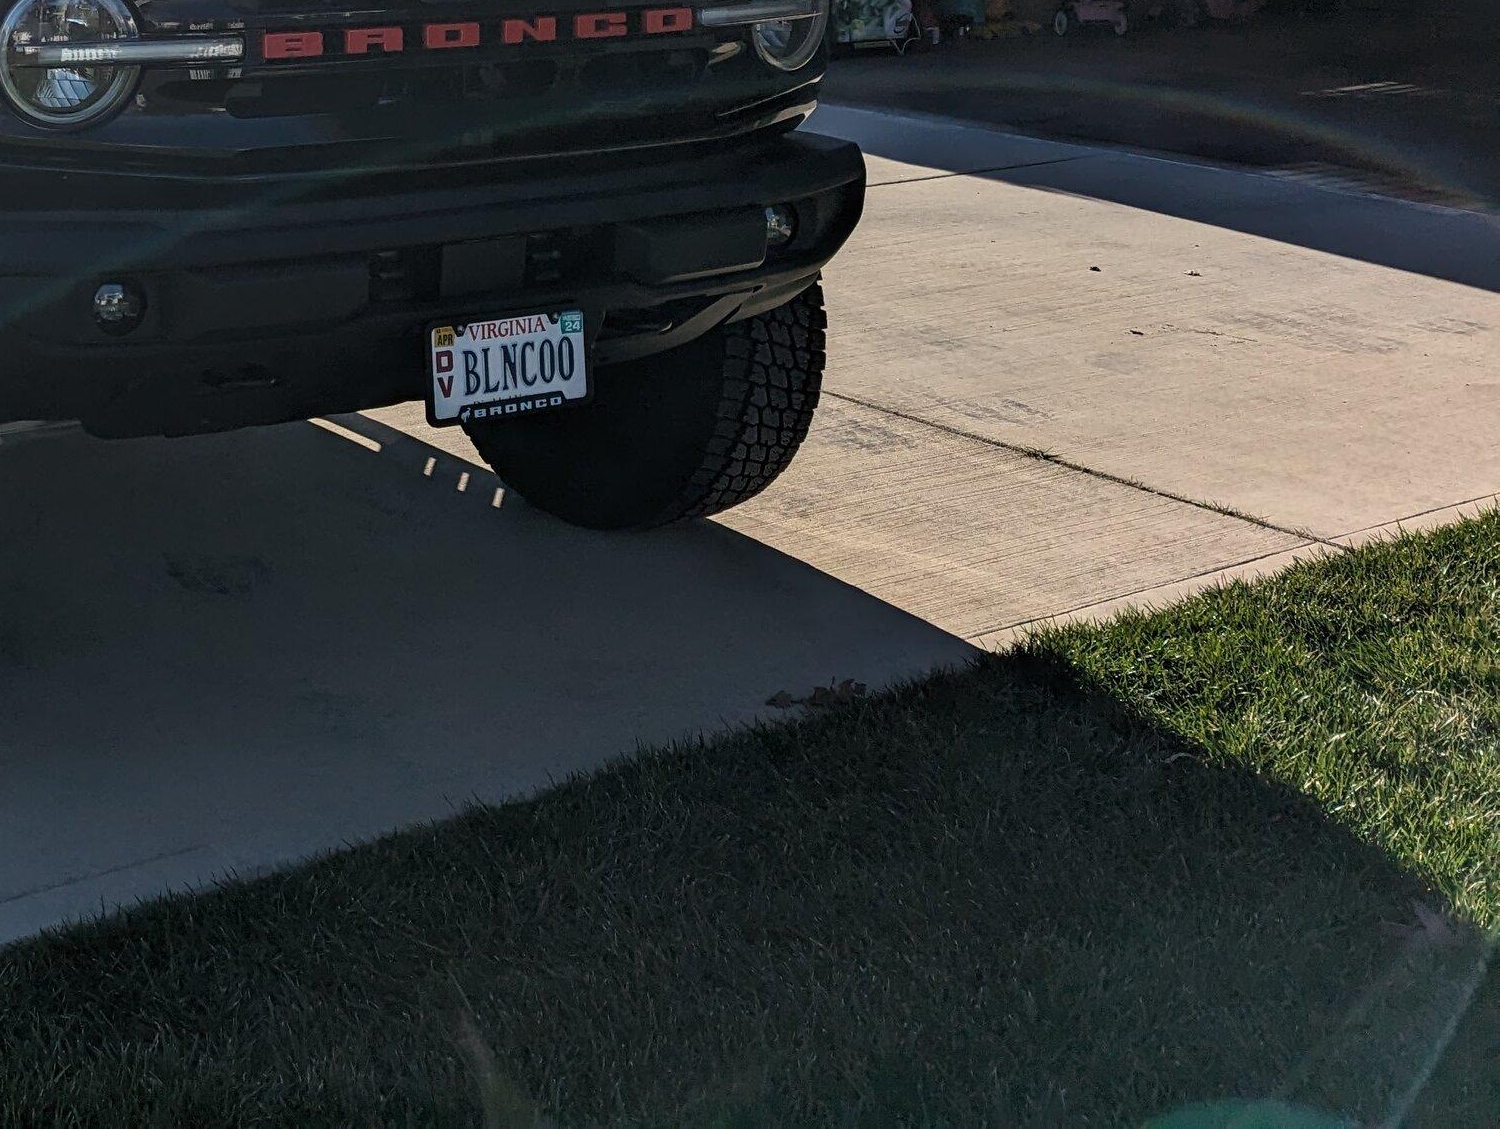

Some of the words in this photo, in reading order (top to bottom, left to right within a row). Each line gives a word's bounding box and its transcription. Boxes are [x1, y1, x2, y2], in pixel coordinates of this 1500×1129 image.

[262, 8, 692, 58] BRONCO
[468, 316, 547, 342] VIRGINIA
[565, 320, 581, 332] 24
[437, 333, 453, 346] APR
[474, 396, 562, 418] BRONCO
